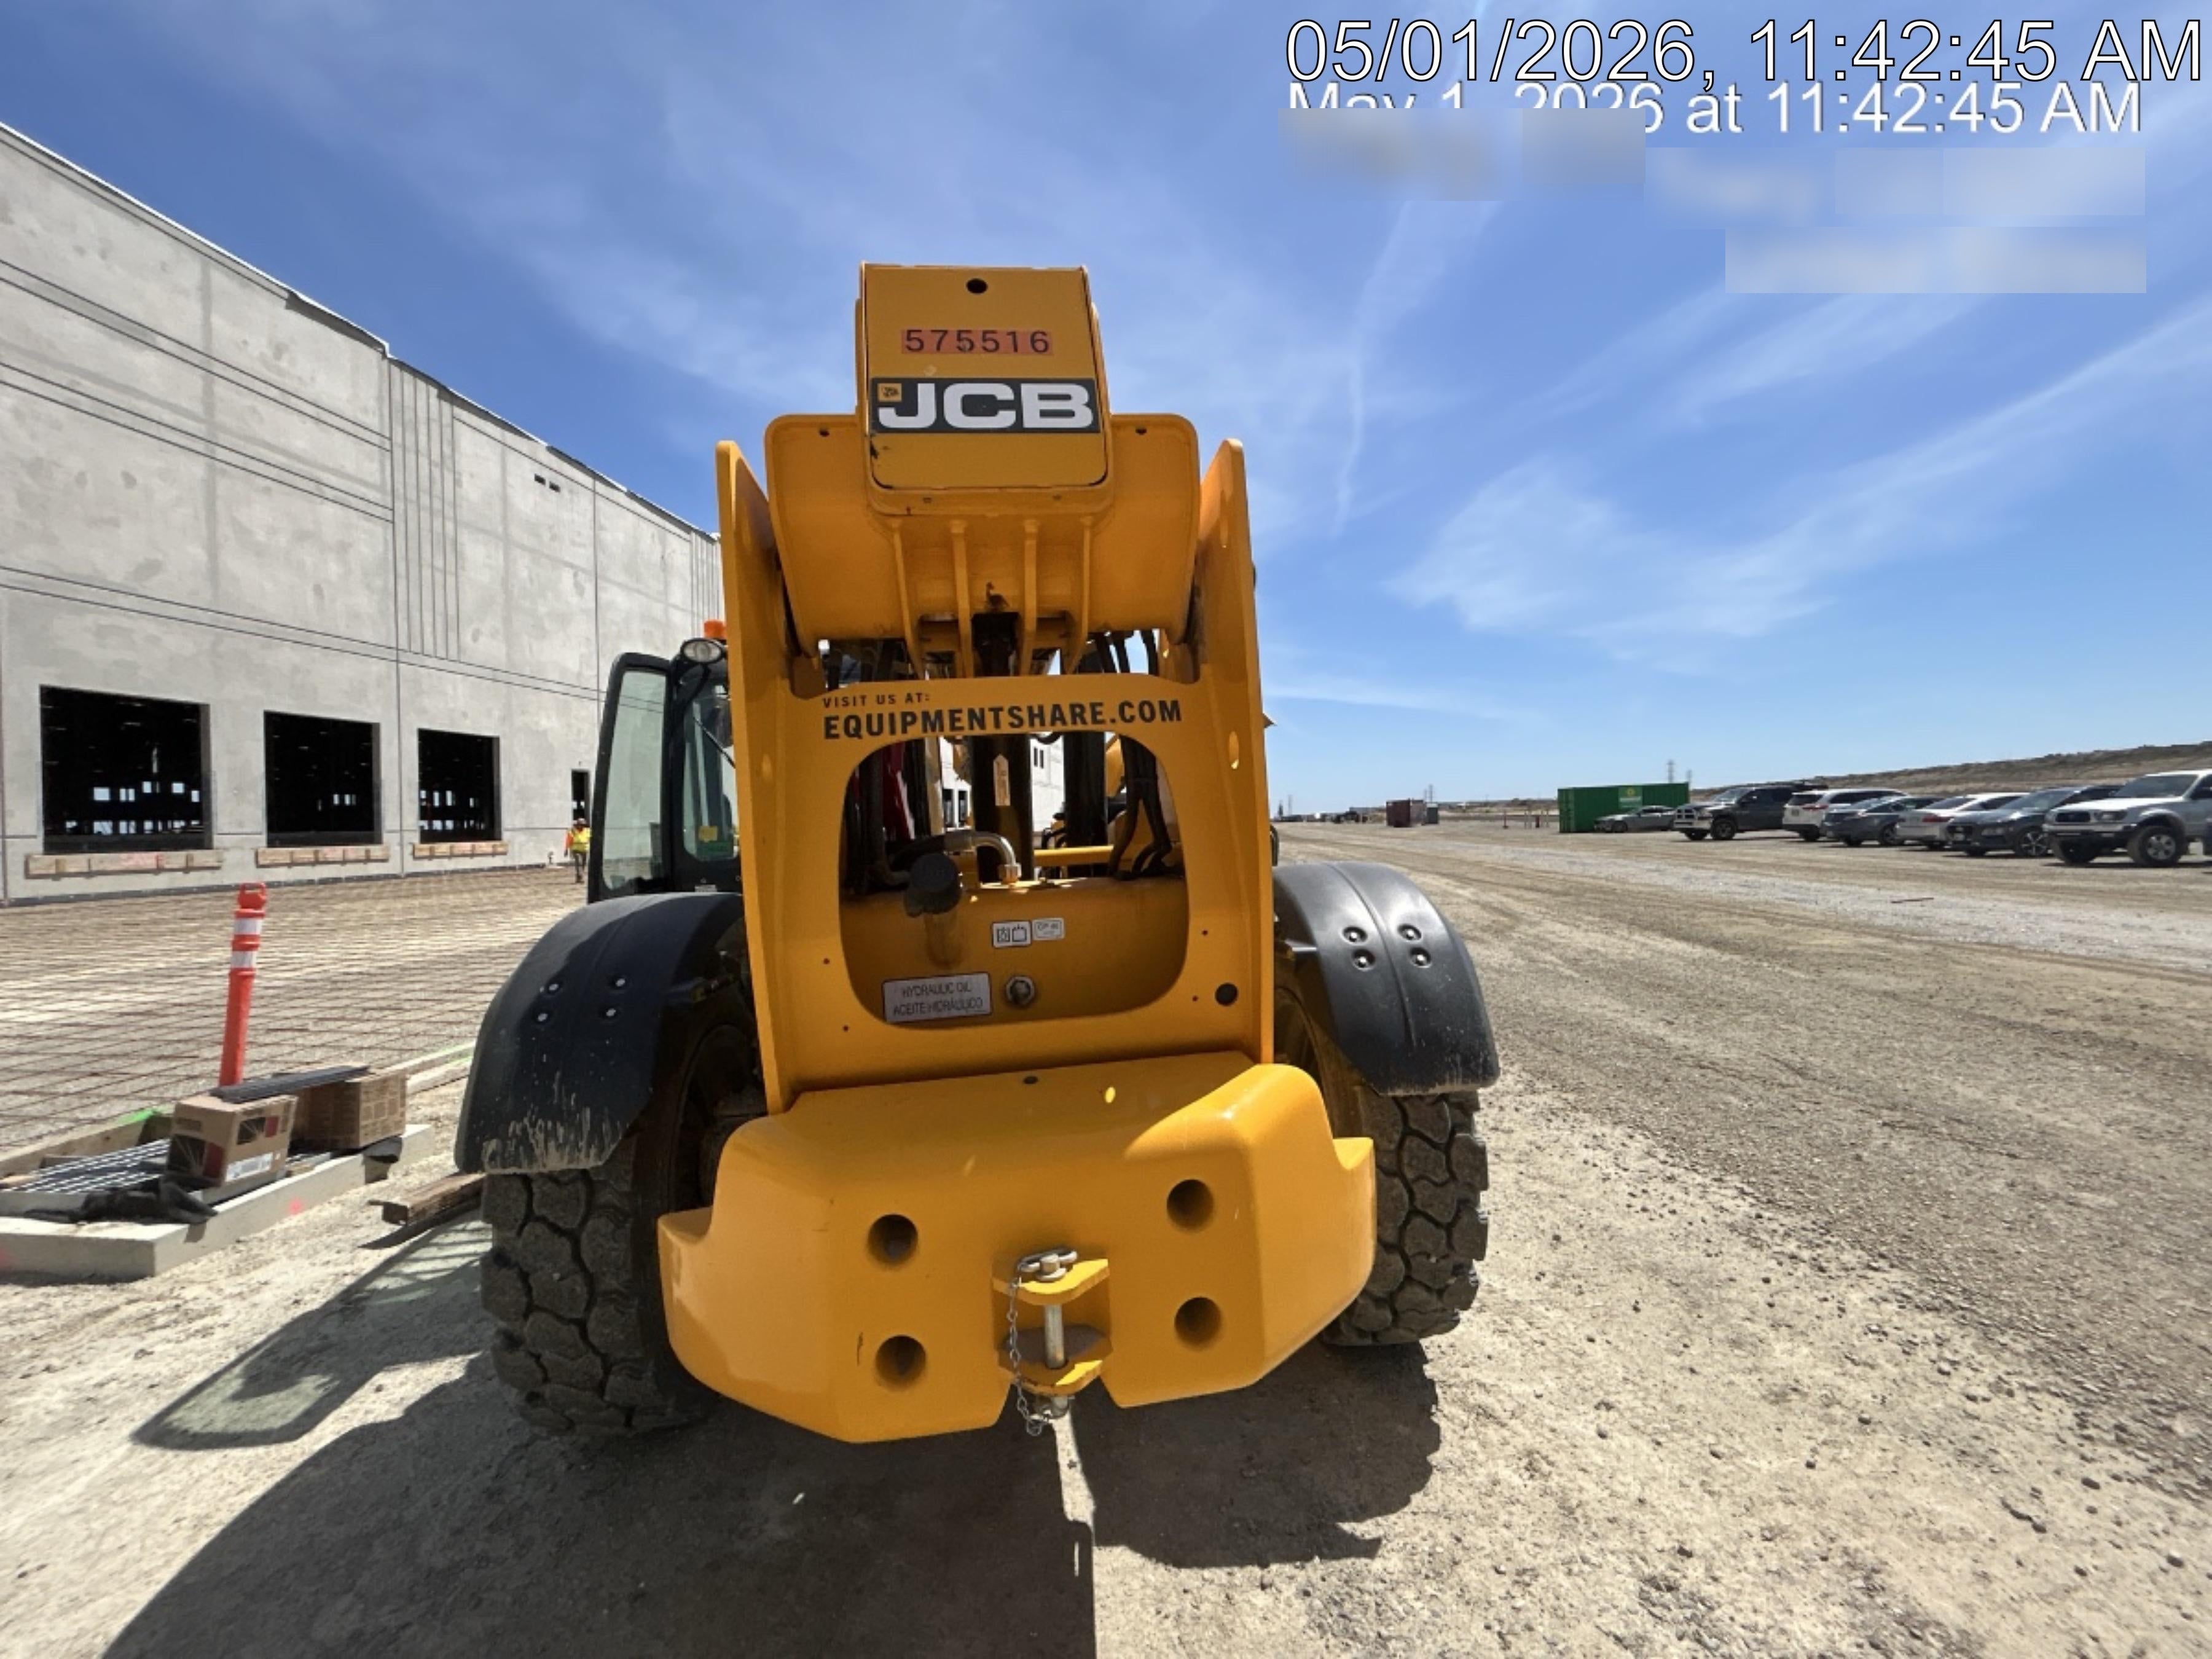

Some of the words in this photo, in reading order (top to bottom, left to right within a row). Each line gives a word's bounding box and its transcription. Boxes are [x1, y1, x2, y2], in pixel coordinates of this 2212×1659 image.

[906, 329, 1049, 353] 575516
[877, 383, 1093, 428] JCB
[823, 694, 867, 708] VISIT
[876, 694, 896, 705] US
[905, 692, 930, 704] AT:
[823, 699, 1182, 739] EQUIPMENTSHARE.COM
